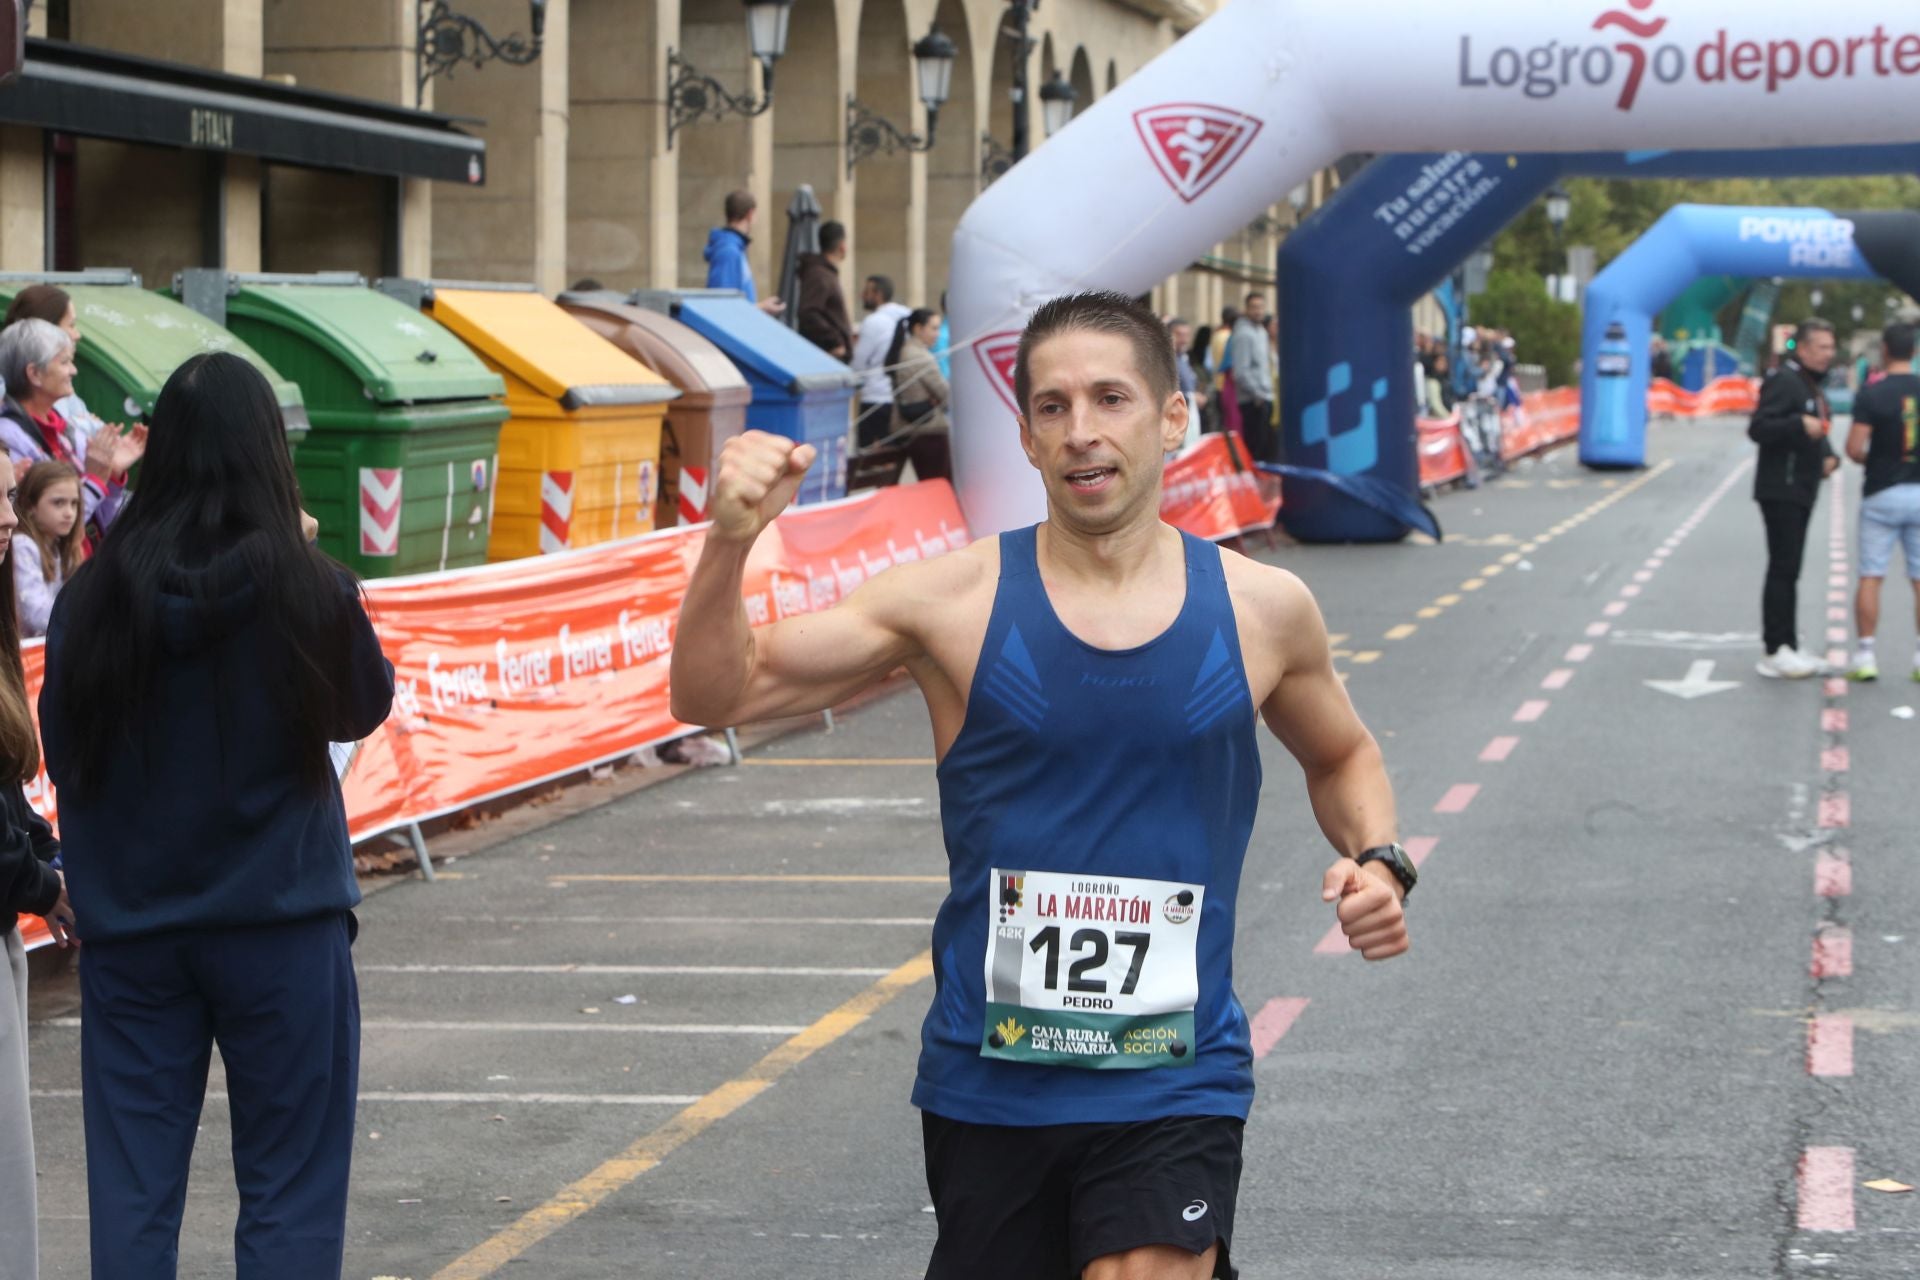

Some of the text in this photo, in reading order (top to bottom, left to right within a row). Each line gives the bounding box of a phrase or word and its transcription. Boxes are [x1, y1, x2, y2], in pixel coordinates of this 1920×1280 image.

[1695, 25, 1920, 93] deporte
[1394, 159, 1484, 240] nuestra
[1373, 196, 1410, 224] Tu
[1739, 217, 1855, 242] POWER
[1071, 881, 1120, 896] LOGROÑO
[1037, 893, 1152, 924] LA MARATÓN
[998, 927, 1023, 939] 42K
[1029, 925, 1152, 995] 127
[1063, 996, 1113, 1010] PEDRO
[1031, 1025, 1112, 1042] CAJA RURAL
[1124, 1027, 1177, 1040] ACCIÓN
[1031, 1038, 1118, 1055] DE NAVARRA
[1124, 1042, 1170, 1054] SOCIA
